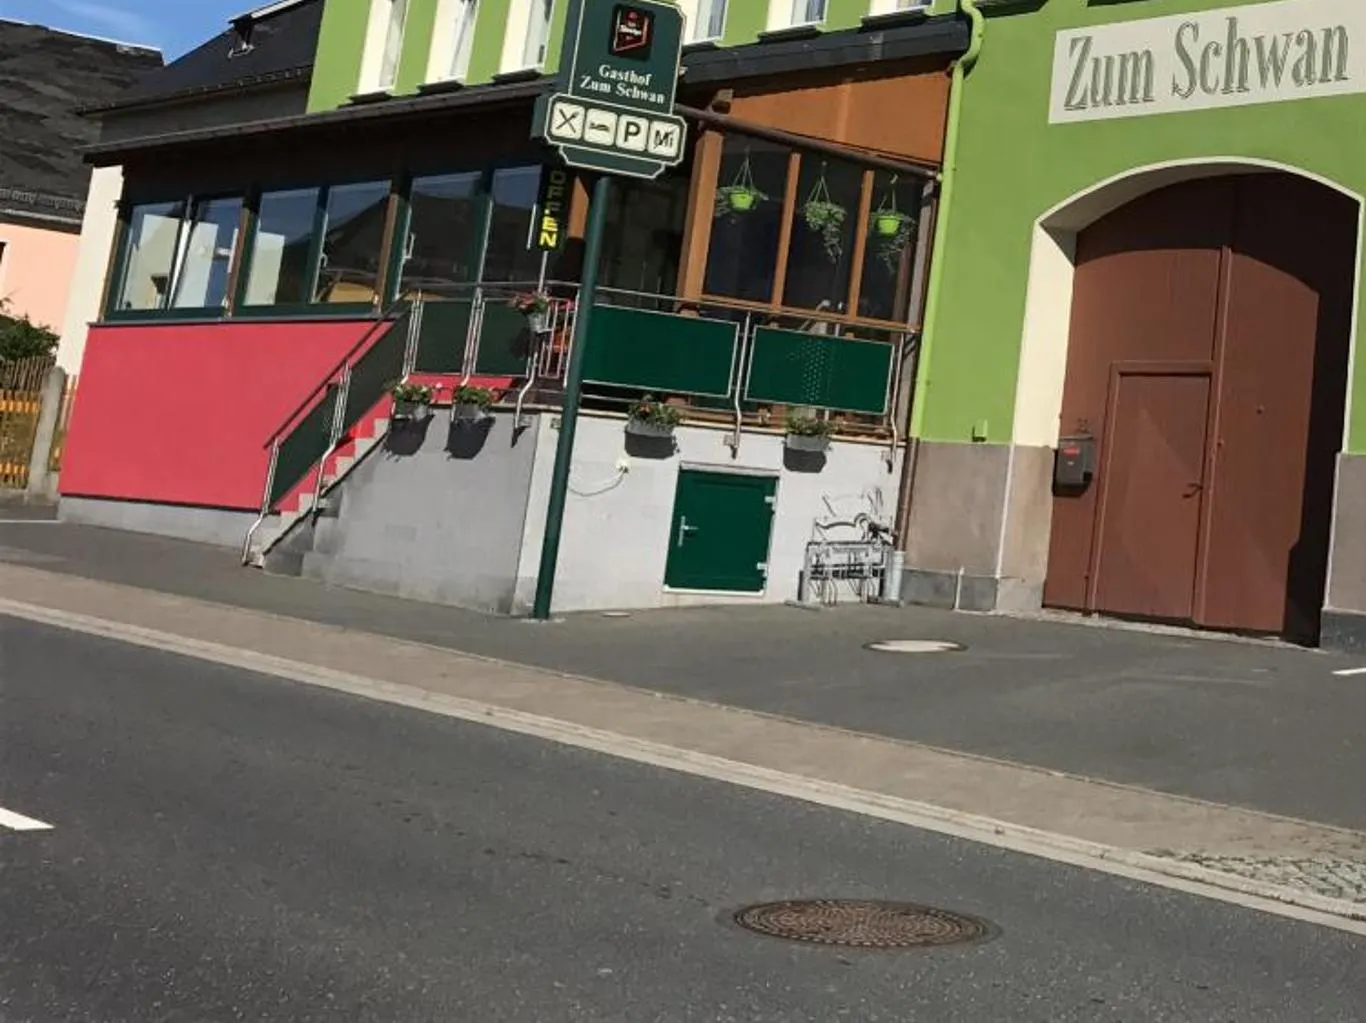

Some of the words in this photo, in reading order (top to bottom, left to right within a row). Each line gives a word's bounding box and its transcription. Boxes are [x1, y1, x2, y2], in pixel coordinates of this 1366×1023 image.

[599, 64, 652, 86] Gasthof
[1064, 35, 1155, 111] Zum
[1171, 16, 1350, 100] Schwan
[580, 75, 611, 93] Zum
[615, 82, 665, 104] Schwan
[624, 121, 641, 142] P
